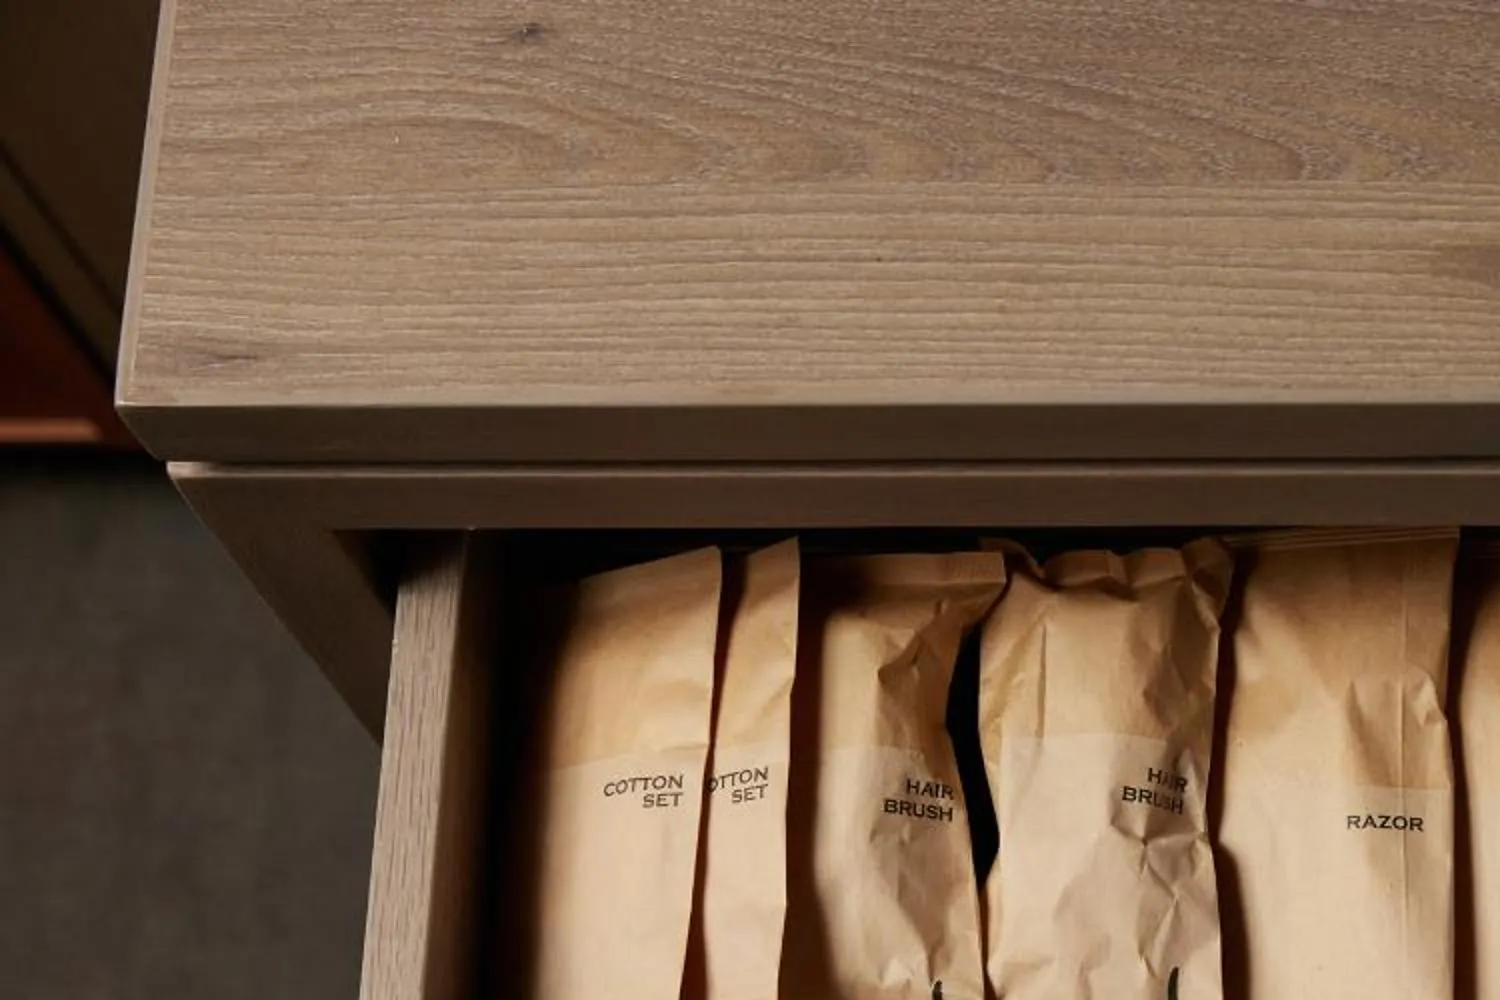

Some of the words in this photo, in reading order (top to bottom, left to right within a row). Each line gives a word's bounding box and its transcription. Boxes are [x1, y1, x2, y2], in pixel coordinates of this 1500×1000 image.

[602, 773, 684, 797] COTTON
[905, 778, 954, 800] HAIR
[1146, 767, 1188, 794] HAIR
[642, 792, 685, 808] SET
[731, 783, 769, 803] SET
[1121, 785, 1184, 815] BRUSH
[883, 797, 954, 822] BRUSH
[1346, 814, 1424, 832] RAZOR
